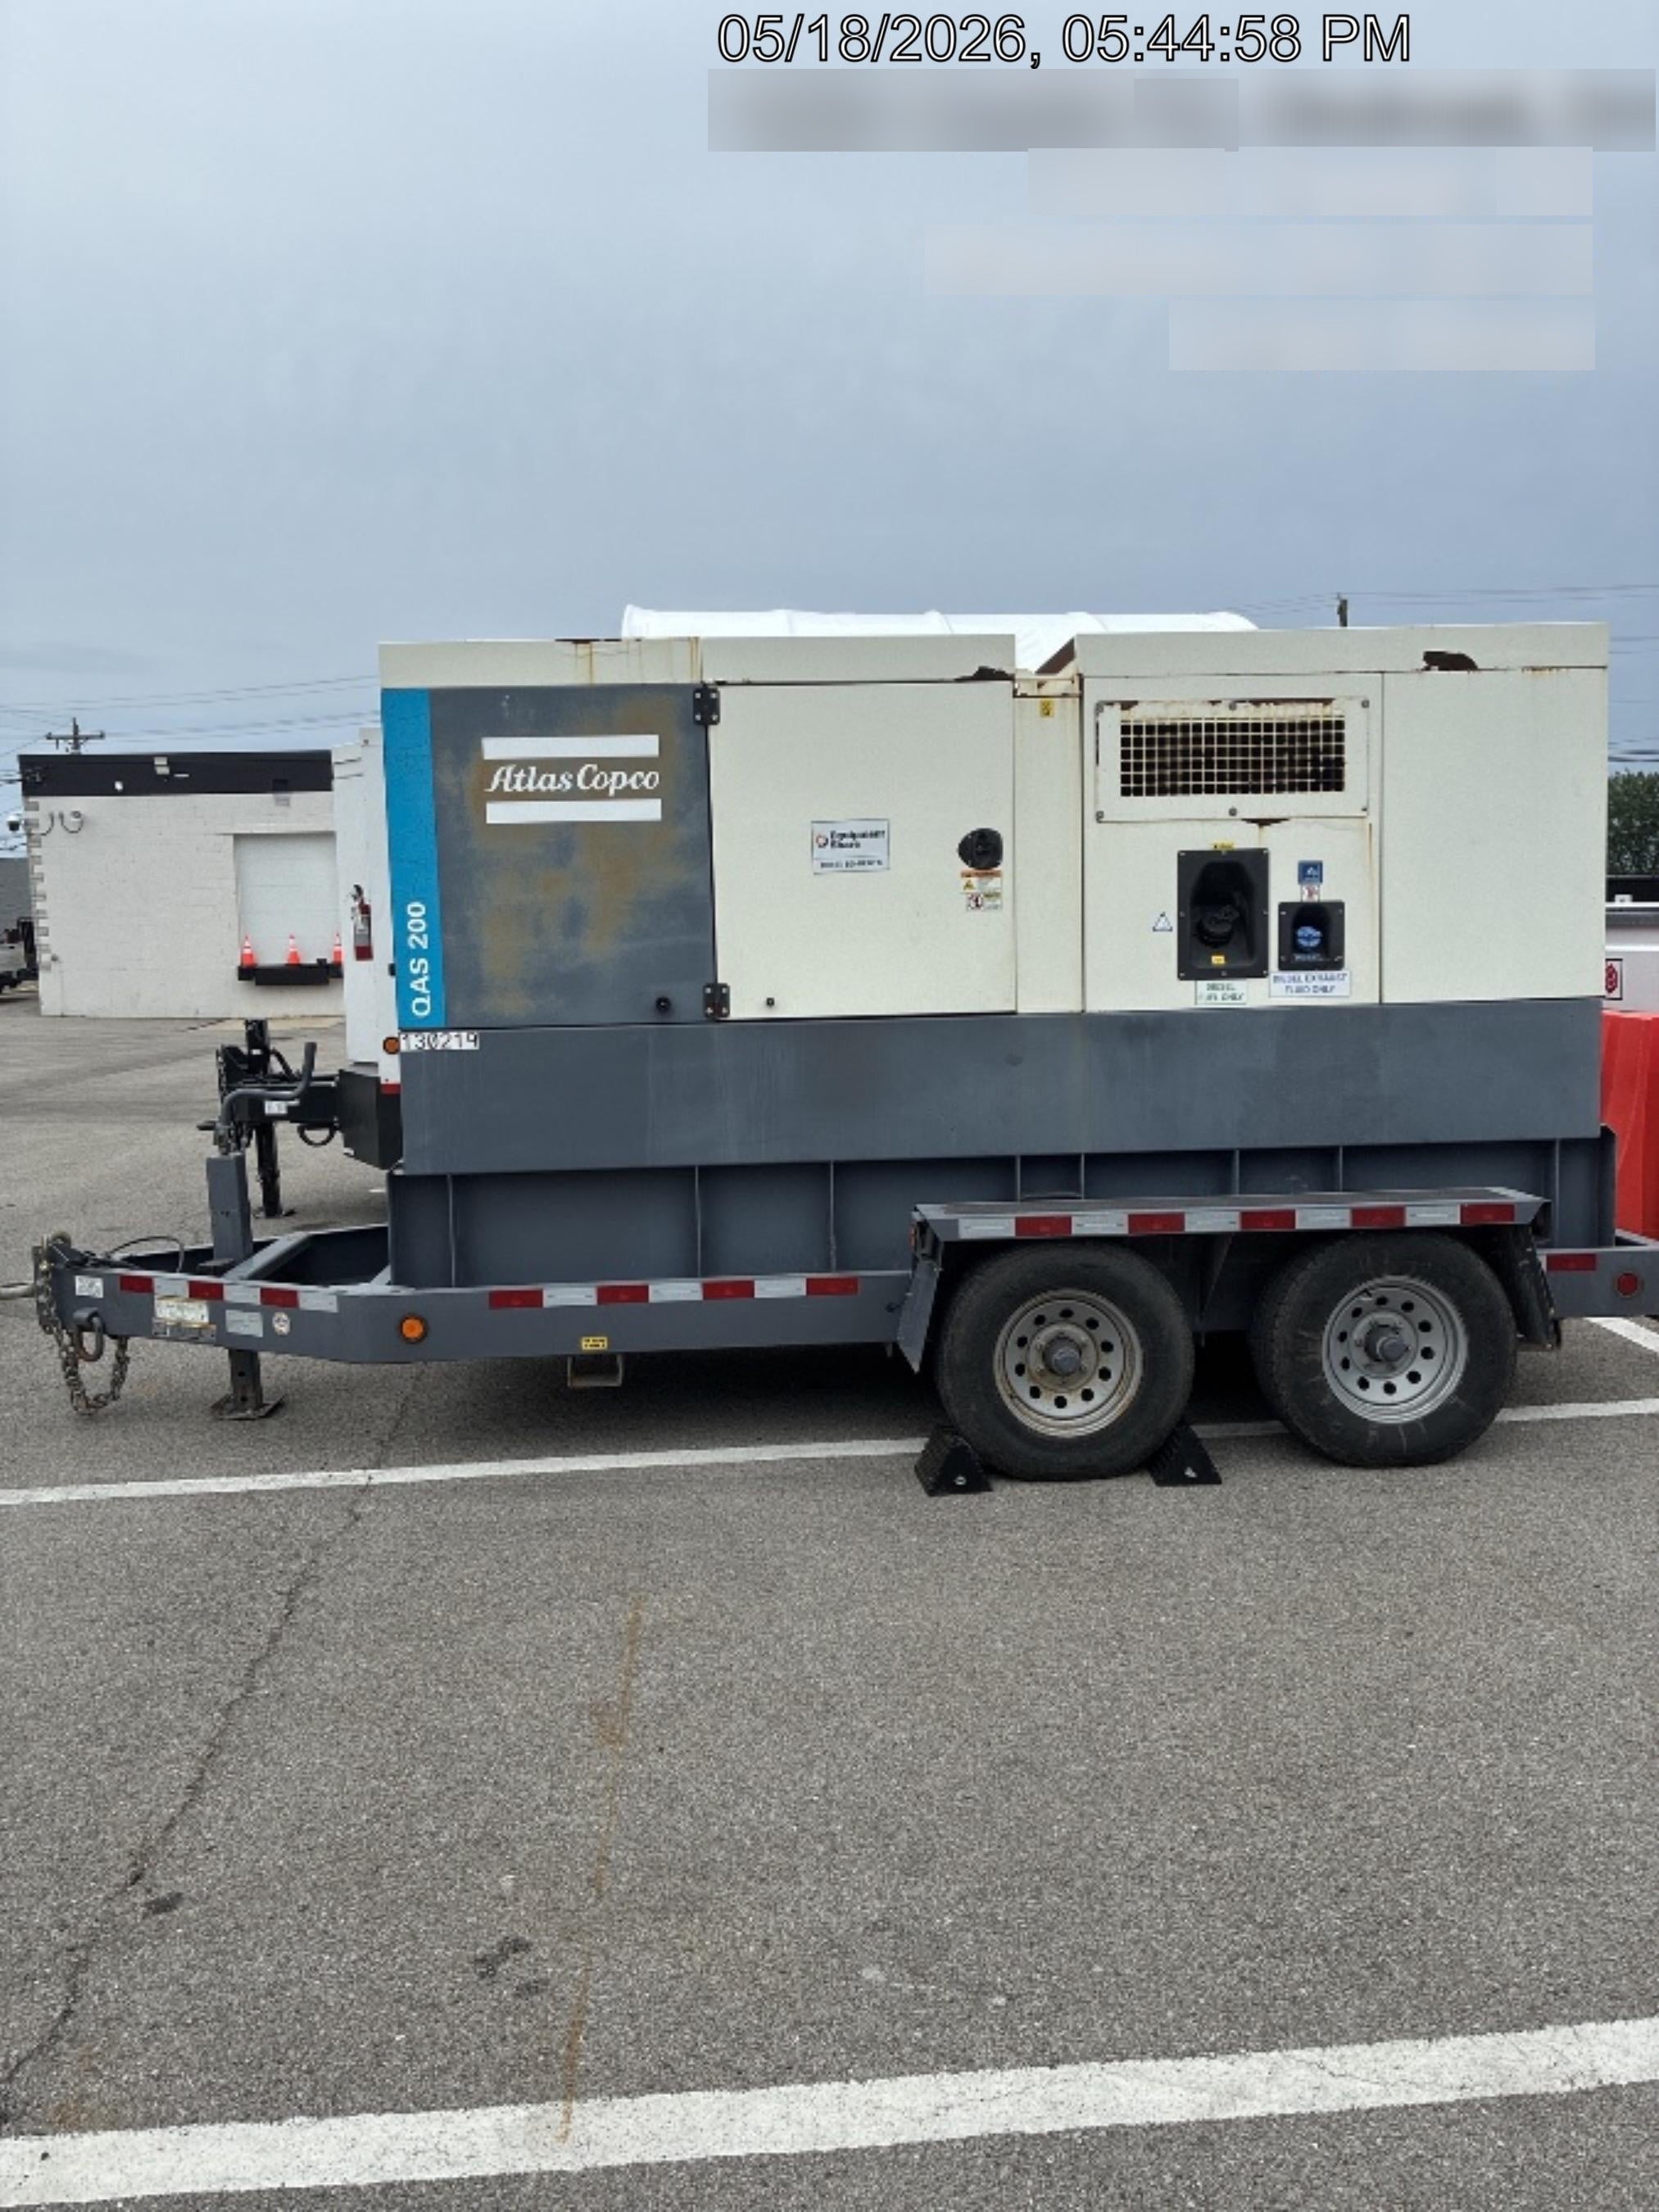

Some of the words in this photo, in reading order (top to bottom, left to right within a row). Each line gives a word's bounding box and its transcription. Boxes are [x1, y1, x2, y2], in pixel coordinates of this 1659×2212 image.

[484, 764, 573, 792] Atlas
[576, 763, 660, 797] Copco
[407, 901, 429, 950] 200
[410, 958, 431, 1018] QAS
